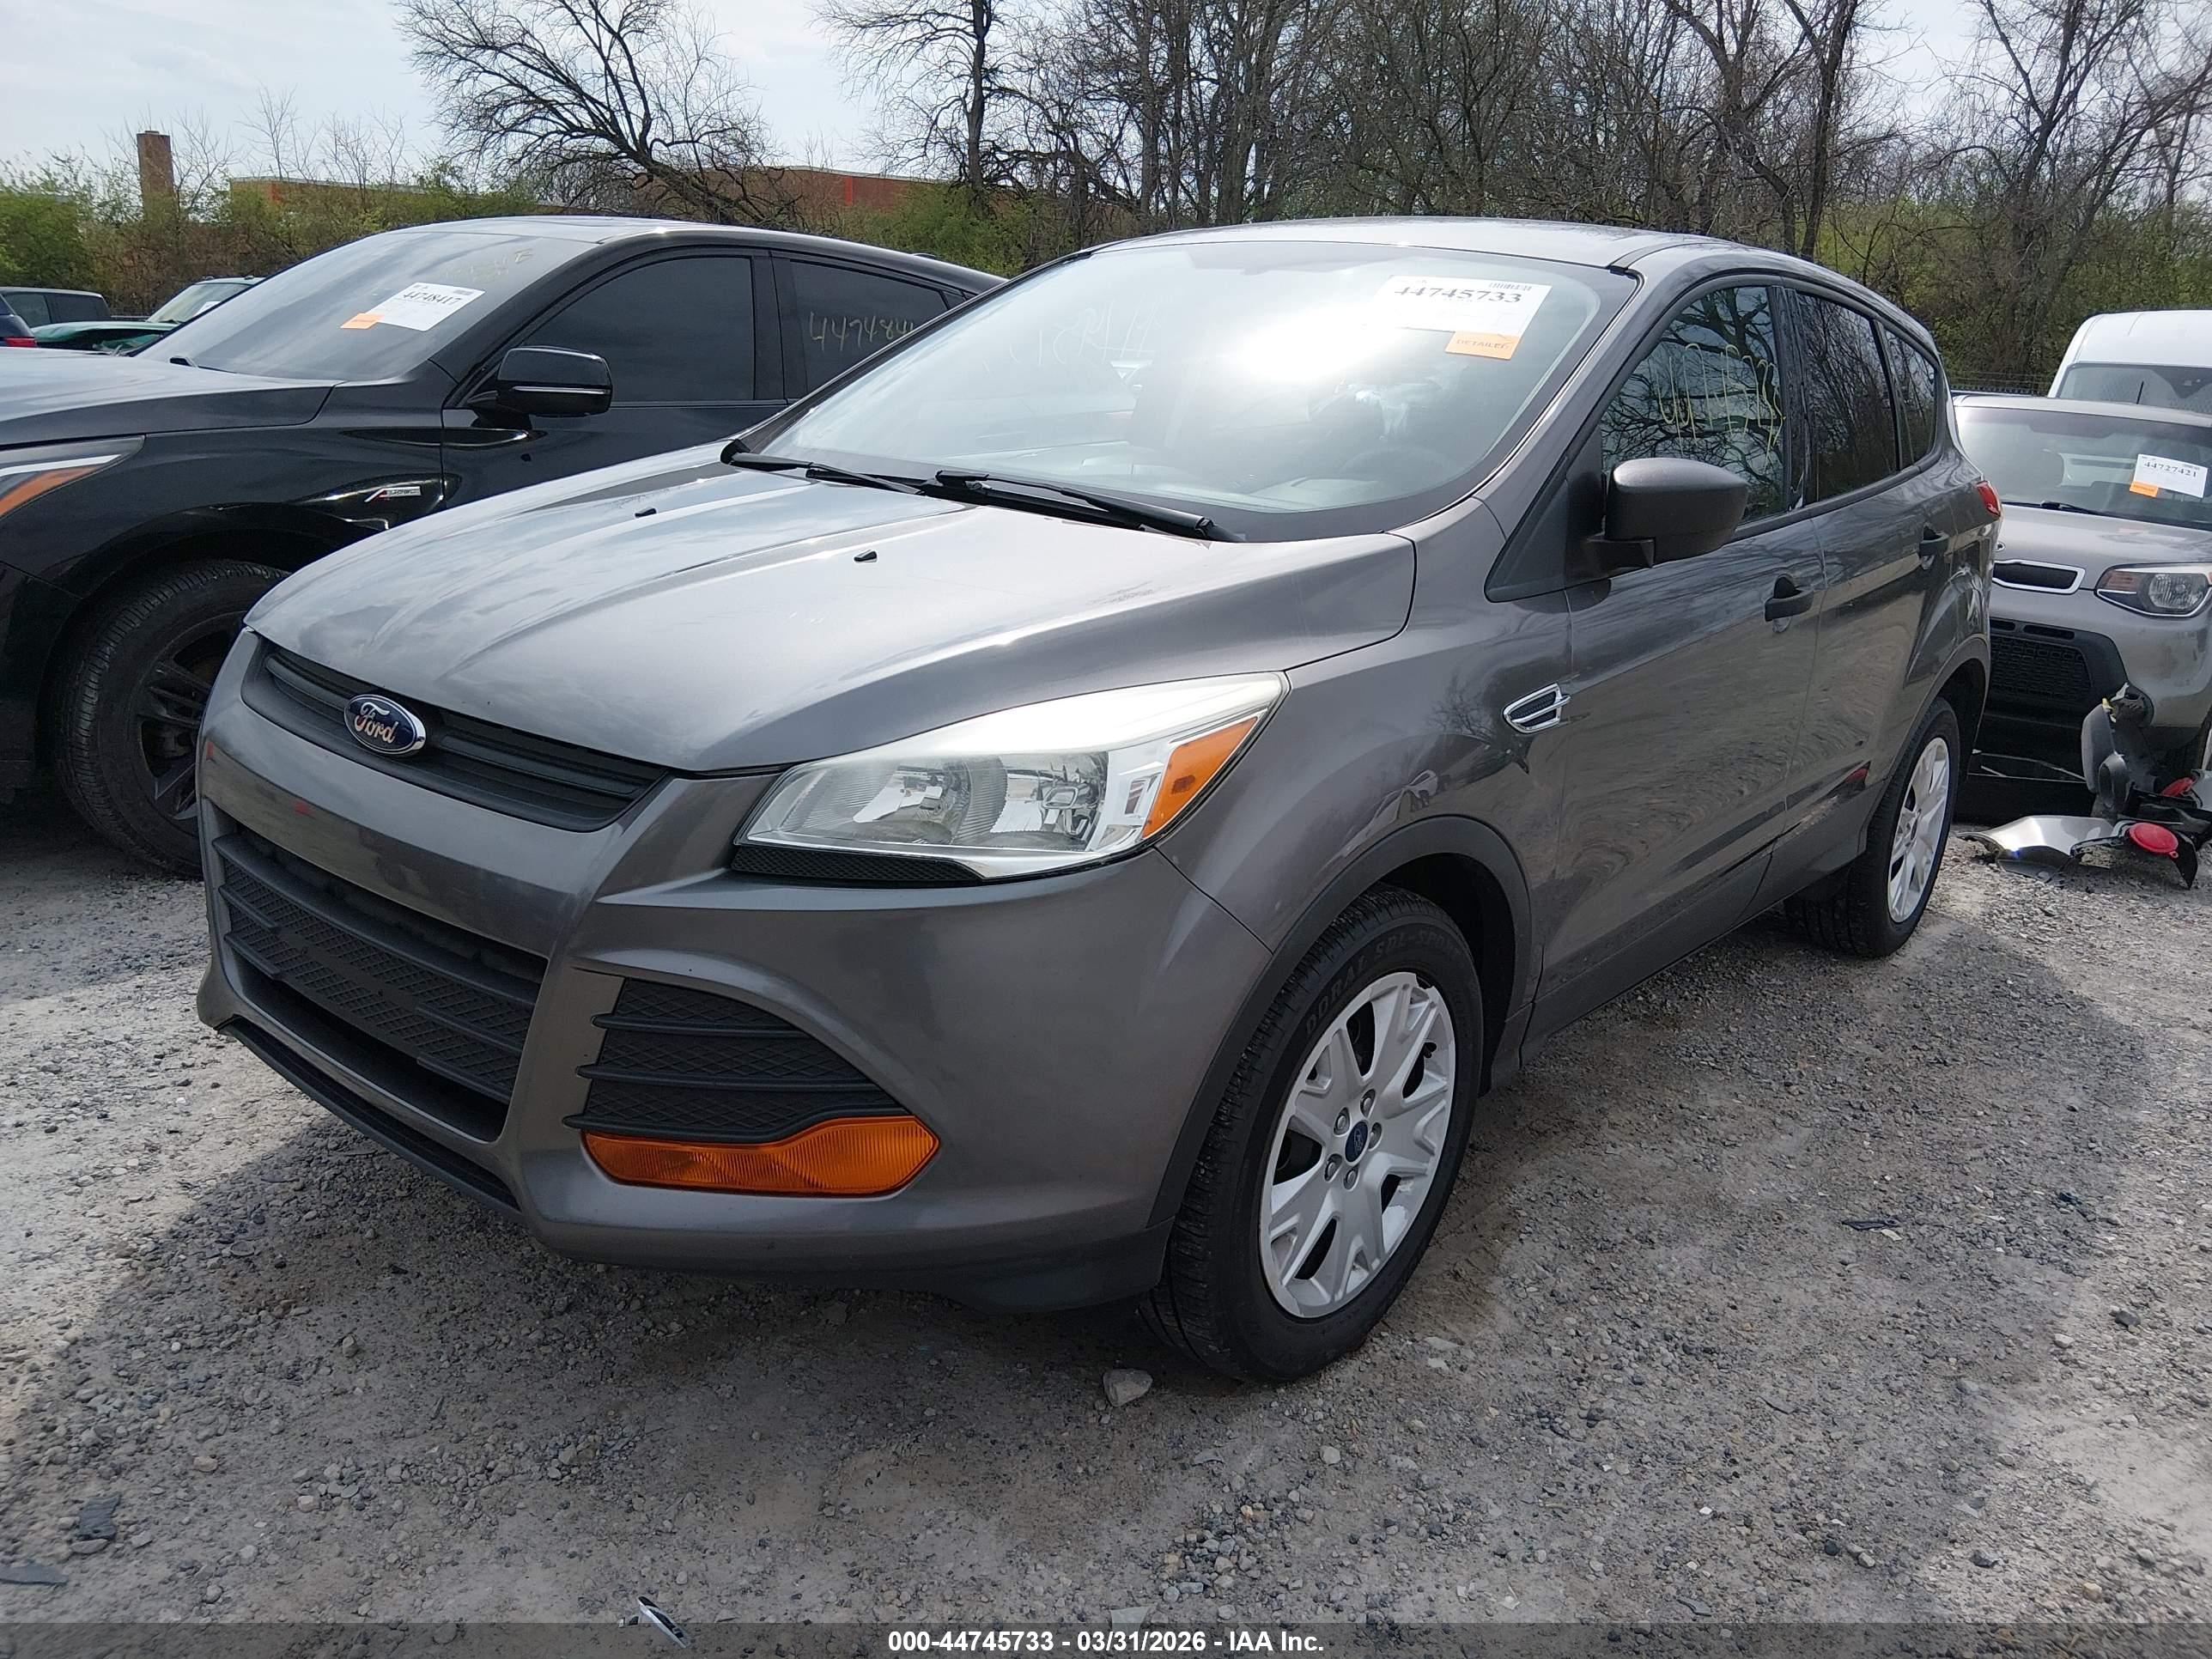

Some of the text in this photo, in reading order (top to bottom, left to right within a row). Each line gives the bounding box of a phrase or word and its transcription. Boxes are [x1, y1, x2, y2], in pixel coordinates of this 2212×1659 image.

[403, 291, 463, 306] 44748417
[1394, 287, 1522, 303] 44745733
[2144, 461, 2197, 477] 44727421
[354, 702, 399, 744] Ford
[1305, 955, 1369, 1036] DORAL
